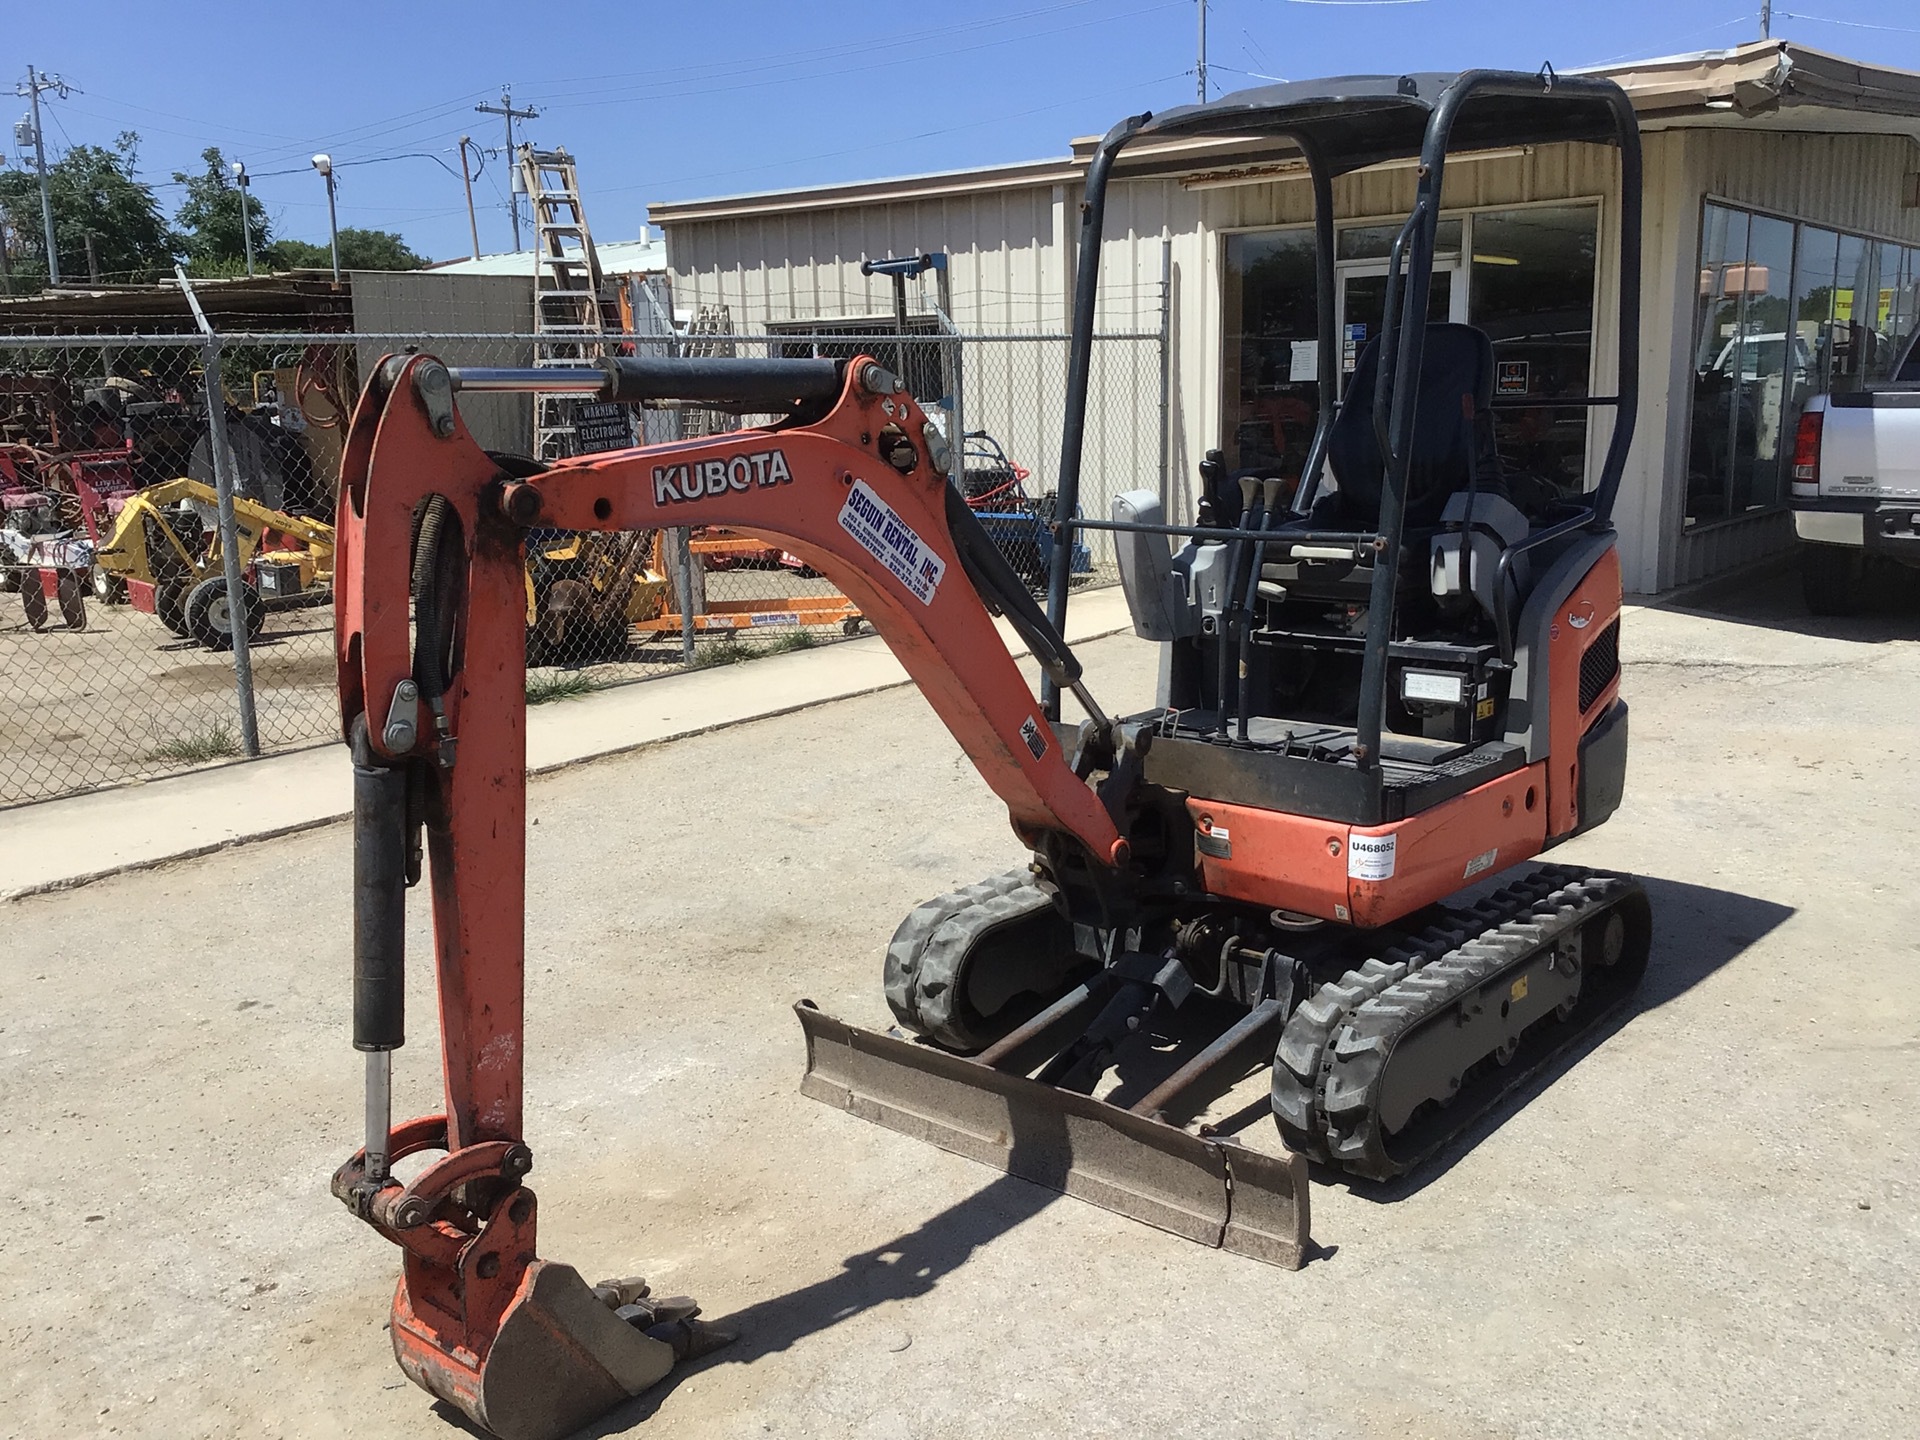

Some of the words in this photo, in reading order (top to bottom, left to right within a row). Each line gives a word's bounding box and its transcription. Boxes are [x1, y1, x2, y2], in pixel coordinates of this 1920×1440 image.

[582, 405, 619, 419] WARNING
[581, 425, 626, 440] ELECTRONIC
[584, 440, 608, 451] SECURITY
[653, 449, 792, 504] KUBOTA
[848, 488, 886, 532] SEGUIN
[881, 520, 919, 570] RENTAL,
[885, 508, 911, 535] PROPERTY
[910, 531, 918, 541] OF
[1352, 841, 1394, 853] U468052
